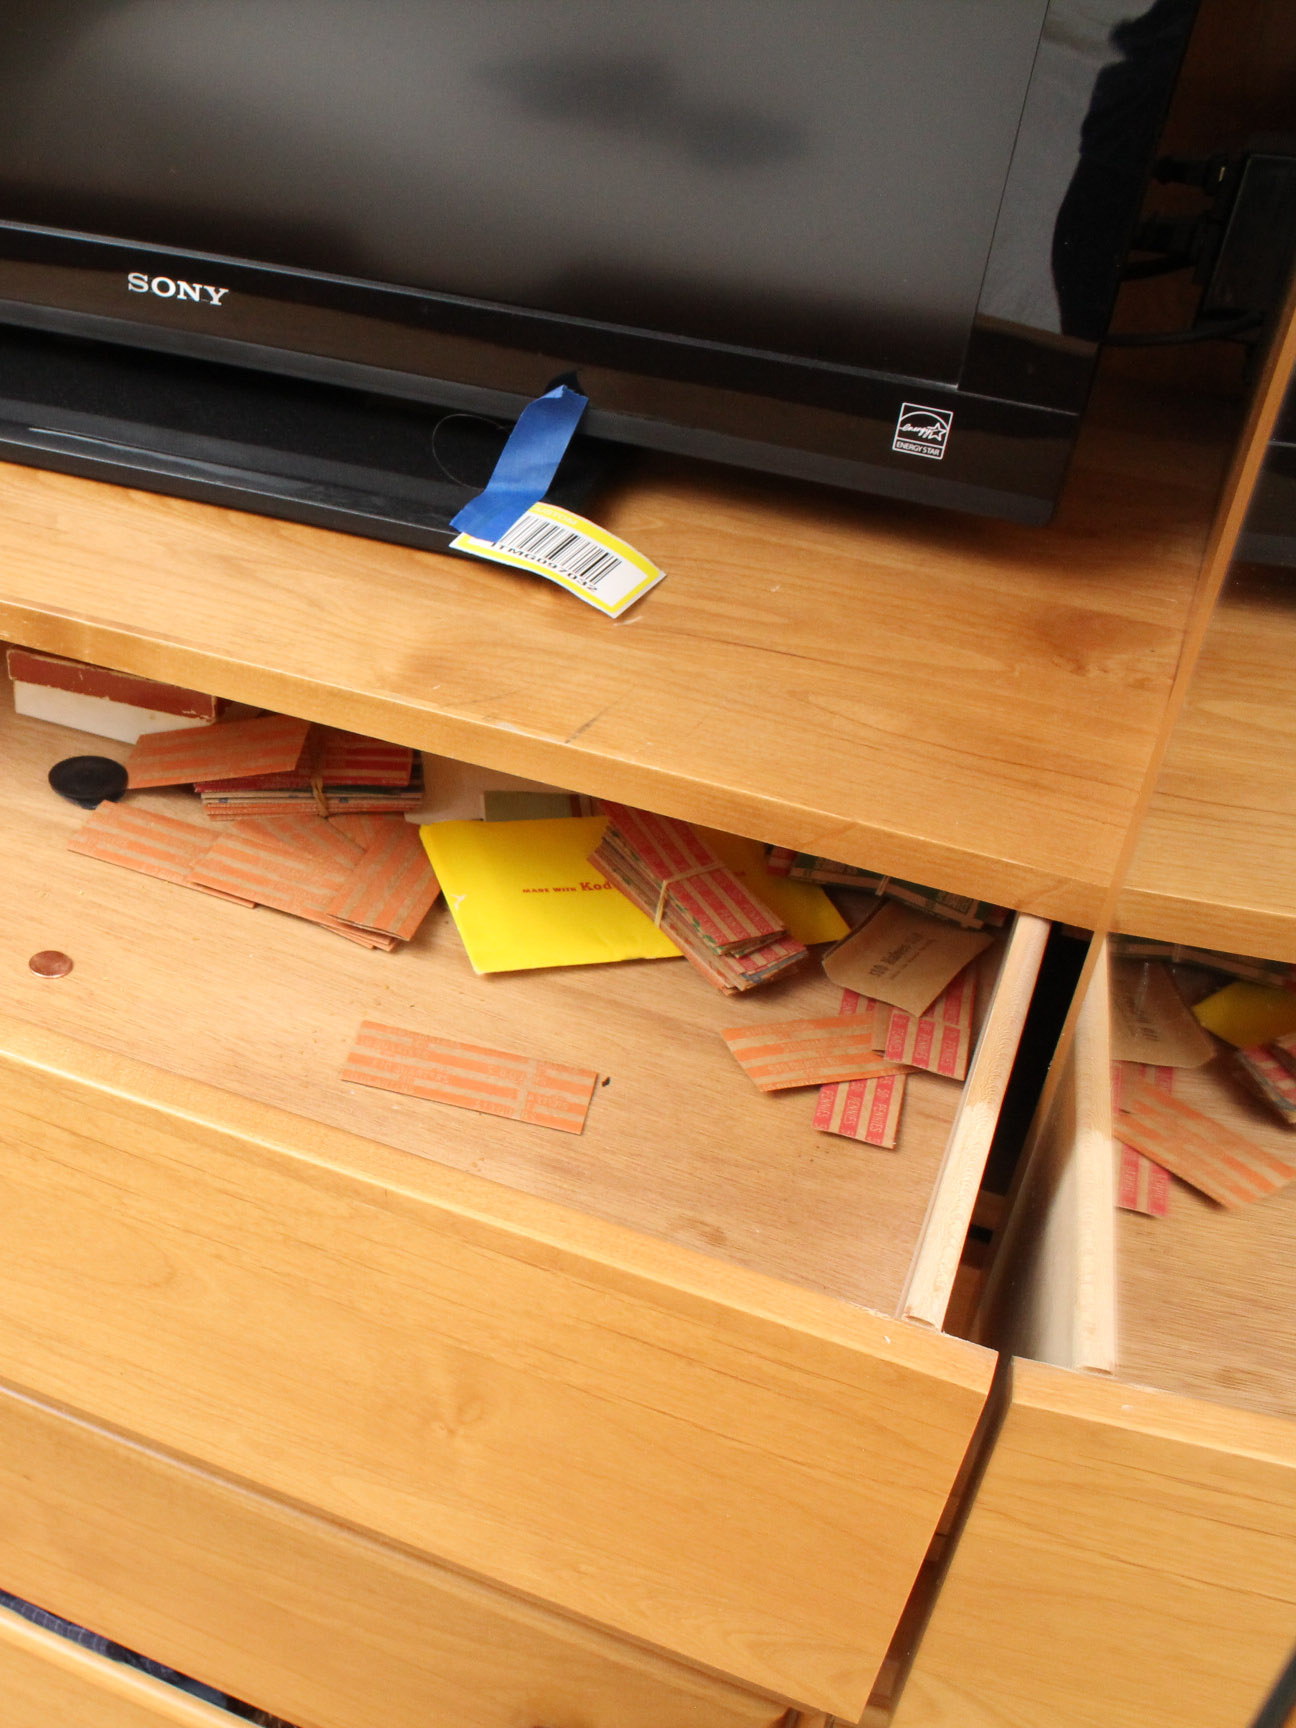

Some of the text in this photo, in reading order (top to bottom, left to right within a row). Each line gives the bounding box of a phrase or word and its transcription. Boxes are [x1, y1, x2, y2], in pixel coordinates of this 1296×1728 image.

[128, 272, 229, 306] SONY
[896, 441, 940, 456] ENERGY STAR
[579, 881, 613, 892] Kod
[869, 1102, 887, 1133] PENNIES
